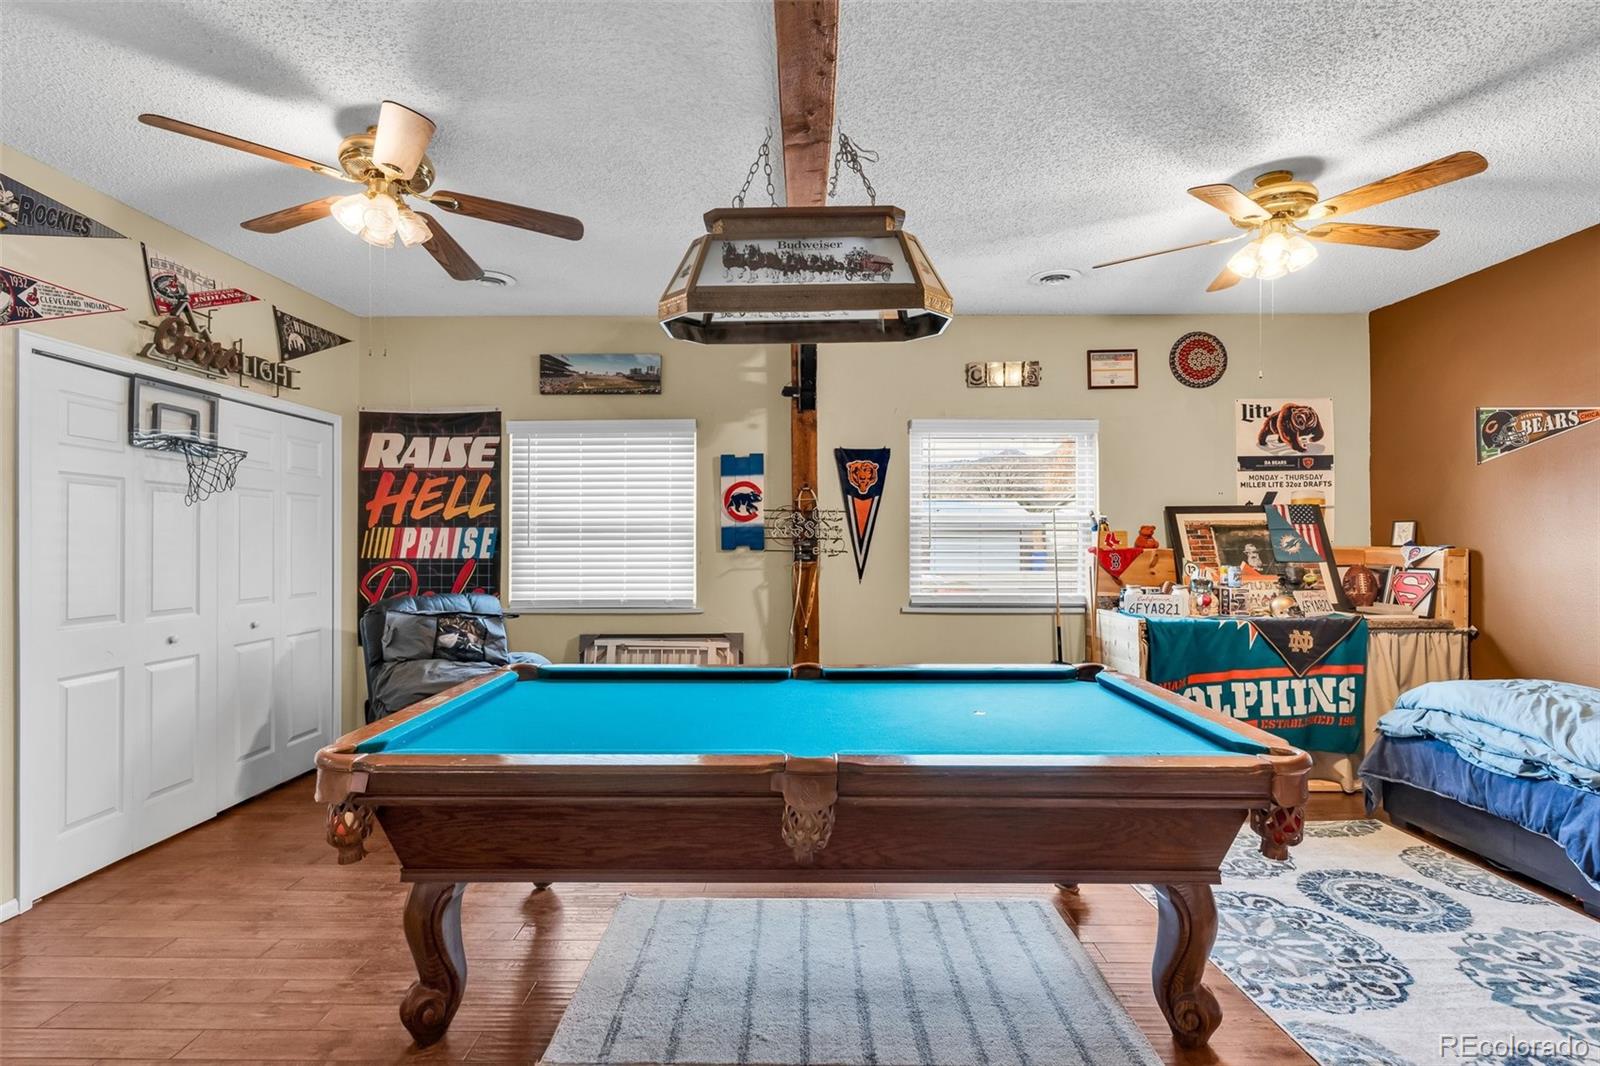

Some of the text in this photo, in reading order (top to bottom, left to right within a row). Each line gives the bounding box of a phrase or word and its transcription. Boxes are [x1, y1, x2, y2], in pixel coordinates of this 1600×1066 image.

[17, 194, 93, 237] ROCKIES
[777, 239, 844, 251] Budweiser
[9, 274, 29, 288] 1932
[39, 295, 111, 311] CLEVELAND INDIANS
[193, 292, 241, 303] INDIANS
[15, 306, 35, 319] 1993
[1241, 403, 1272, 423] Lite
[1521, 410, 1580, 435] BEARS
[363, 432, 501, 469] RAISE
[1240, 481, 1267, 489] MILLER
[1302, 480, 1333, 488] DRAFTS
[1284, 473, 1324, 481] THURSDAY
[365, 471, 496, 528] HELL
[399, 527, 496, 559] PRAISE
[1109, 552, 1121, 570] B
[1128, 602, 1181, 616] 6FYA821
